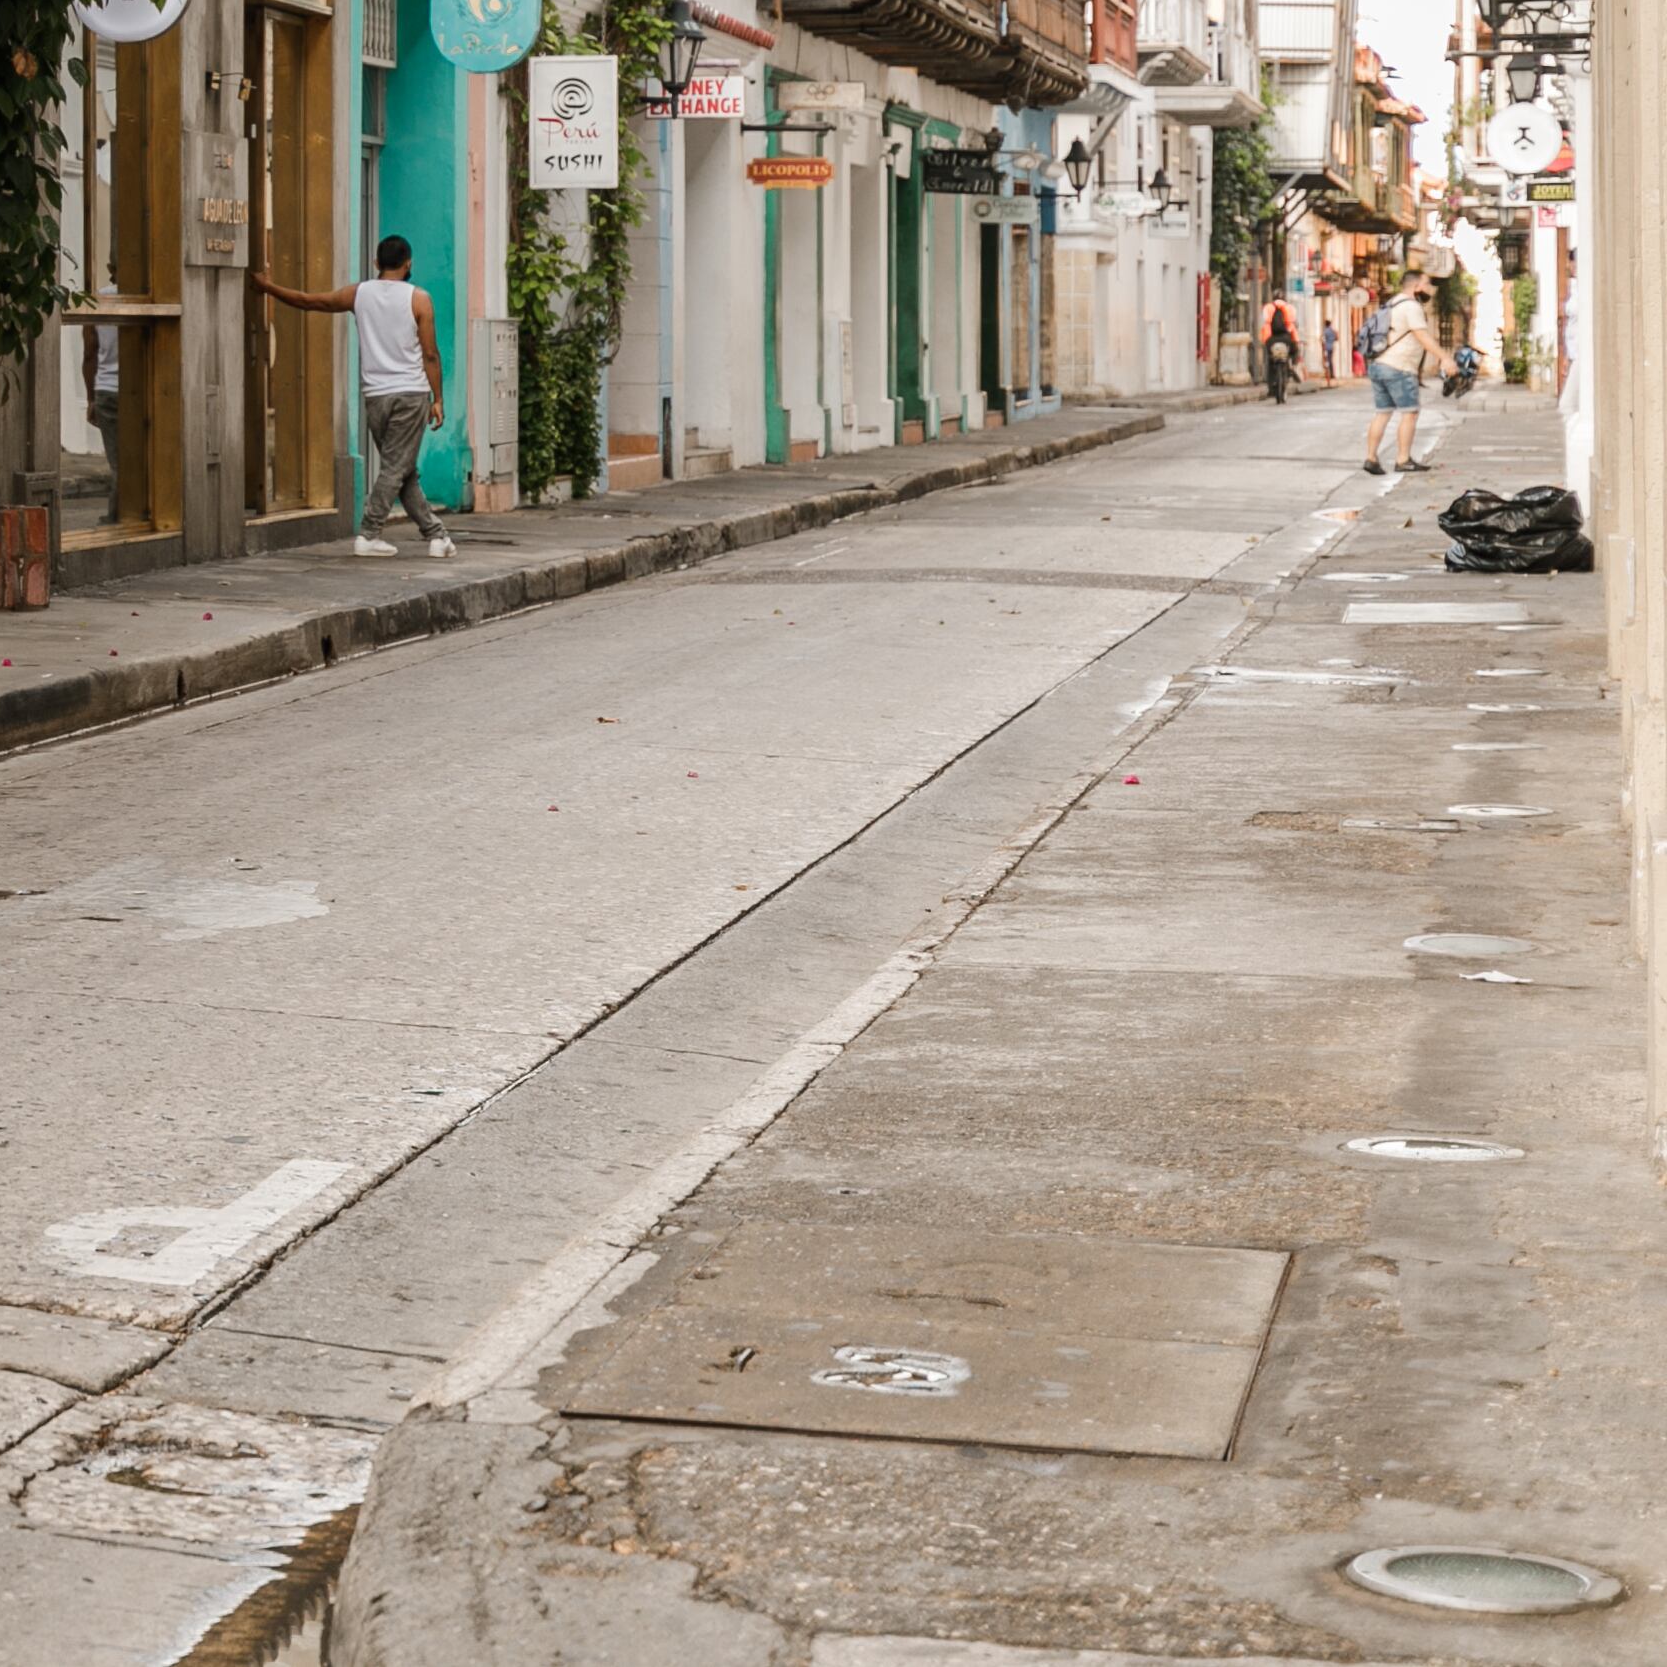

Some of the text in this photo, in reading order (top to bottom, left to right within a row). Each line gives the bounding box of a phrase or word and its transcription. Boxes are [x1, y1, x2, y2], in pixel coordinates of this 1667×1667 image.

[661, 78, 725, 96] NEY
[650, 97, 741, 115] EXHANGE
[537, 117, 601, 148] Perú
[544, 154, 603, 172] SUSHI
[752, 164, 829, 177] LICOPOLIS
